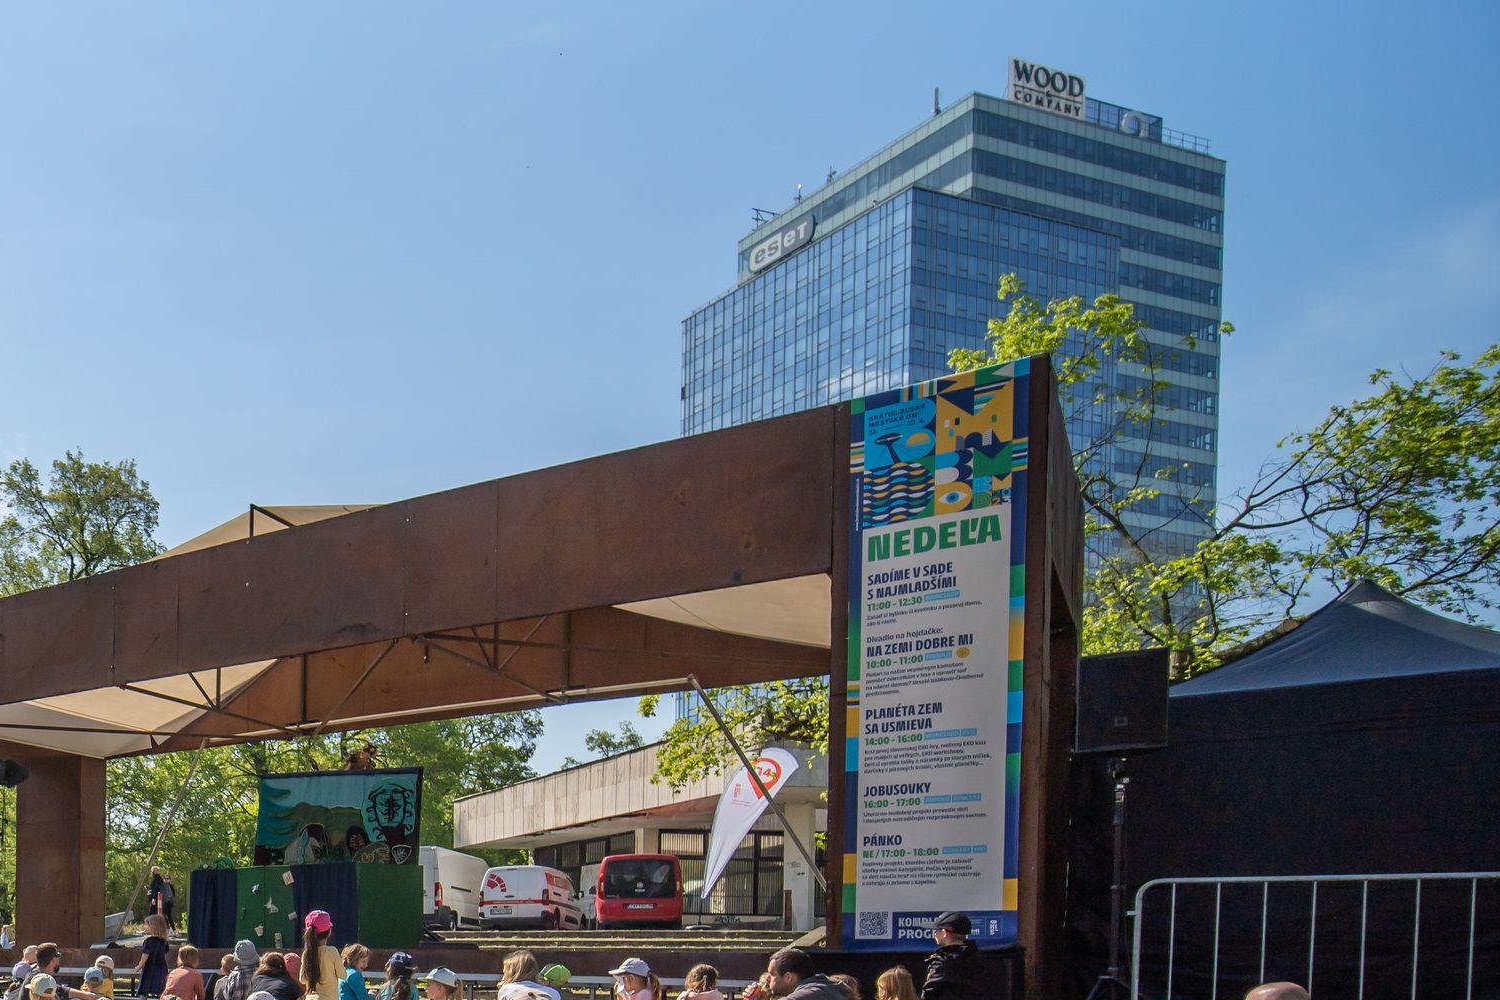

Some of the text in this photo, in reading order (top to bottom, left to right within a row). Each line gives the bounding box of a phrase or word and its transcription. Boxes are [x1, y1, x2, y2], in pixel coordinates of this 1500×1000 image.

[1014, 59, 1084, 97] WOOD
[1014, 90, 1082, 117] COMPANY
[868, 403, 926, 422] BRATISLAVSKÉ
[867, 513, 1002, 562] NEDEĽA
[867, 561, 953, 586] SADÍME V SADE
[867, 575, 956, 599] S NAJMLADŠÍMI
[868, 600, 891, 611] 11:00
[899, 595, 922, 606] 12:30
[906, 626, 943, 639] hojdačke:
[866, 633, 972, 657] NA ZEMI DOBRE MI
[866, 658, 891, 669] 10:00
[900, 654, 923, 664] 11:00
[865, 701, 942, 720] PLANÉTA ZEM
[865, 717, 932, 734] SA USMIEVA
[865, 736, 889, 746] 14:00
[897, 732, 922, 743] 16:00
[863, 782, 931, 797] JOBUSOVKY
[863, 799, 888, 808] 16:00
[896, 797, 920, 806] 17:00
[863, 832, 902, 847] PÁNKO
[881, 848, 905, 857] 17:00
[913, 847, 938, 856] 18:00
